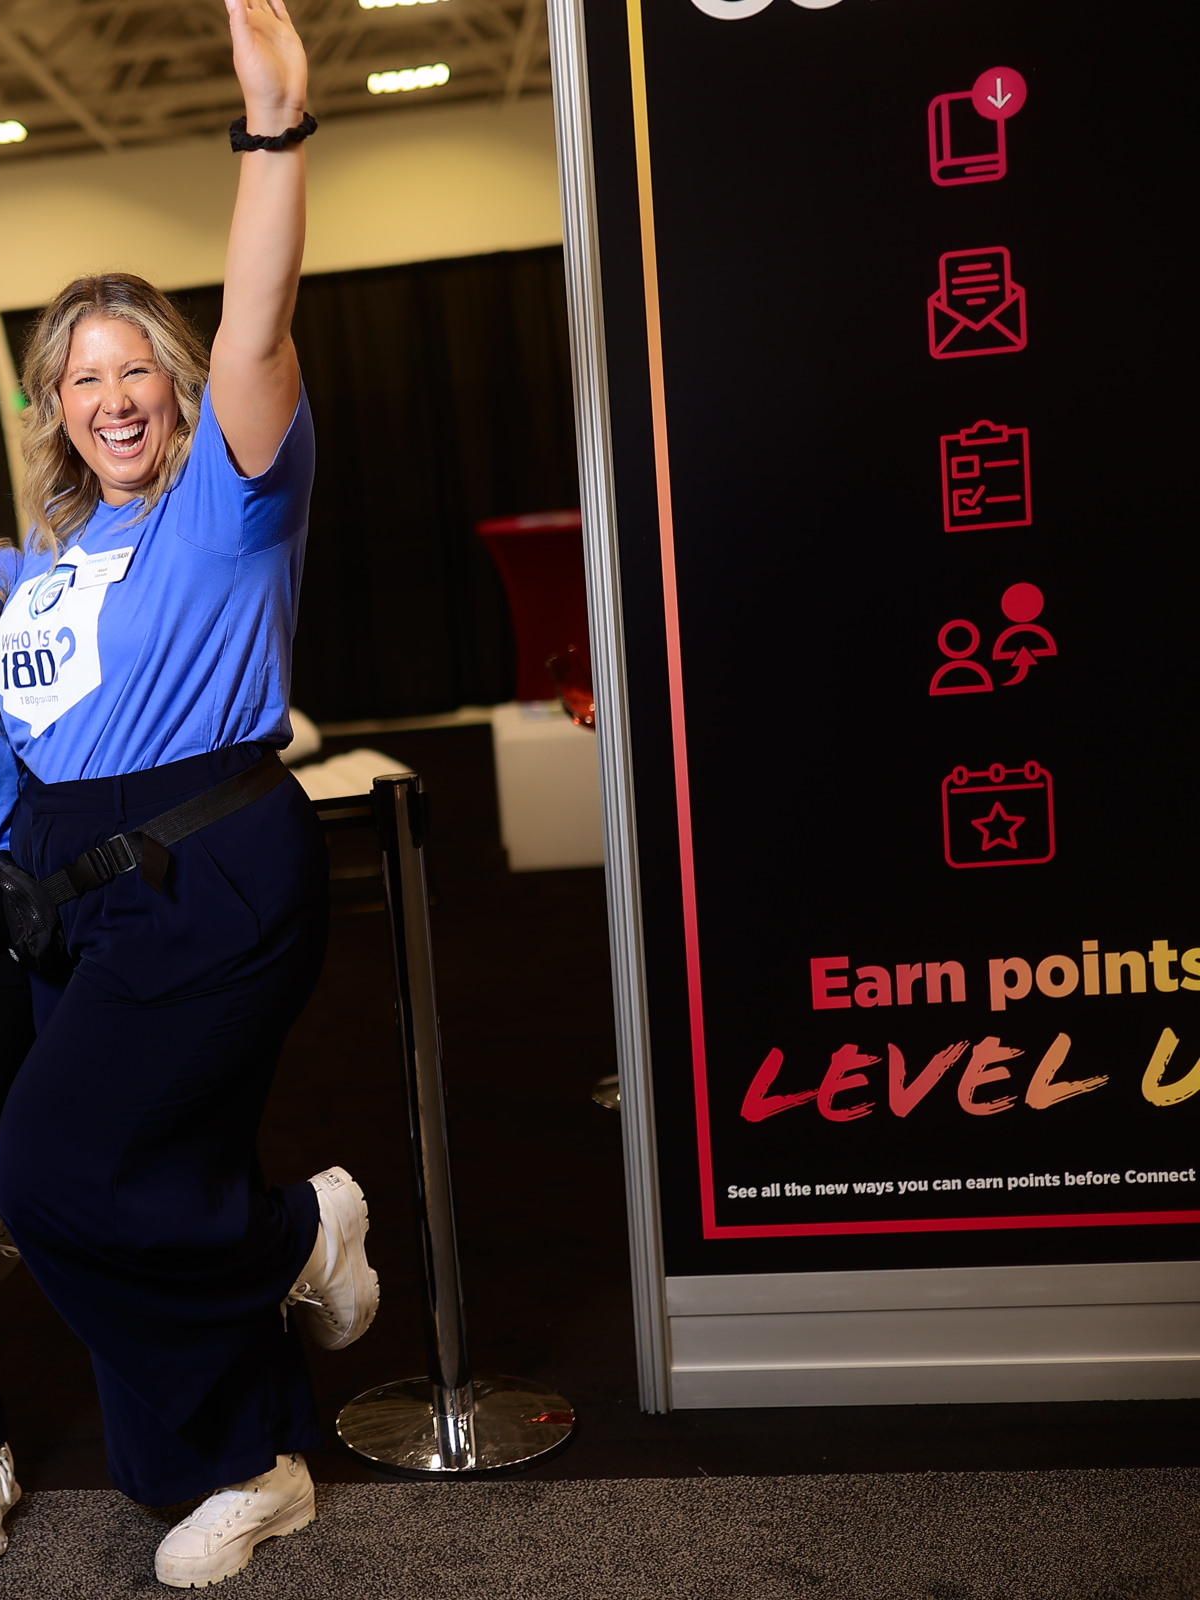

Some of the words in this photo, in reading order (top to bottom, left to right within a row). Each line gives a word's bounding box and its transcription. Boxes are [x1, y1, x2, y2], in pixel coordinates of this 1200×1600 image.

[1, 631, 31, 652] WHO
[37, 629, 51, 648] IS
[810, 955, 967, 1011] Earn
[740, 1031, 1110, 1123] LEVEL
[727, 1184, 758, 1199] See
[760, 1183, 781, 1198] all
[784, 1182, 811, 1197] the
[814, 1183, 849, 1196] new
[852, 1180, 894, 1195] ways
[898, 1180, 929, 1195] you
[932, 1178, 962, 1191] can
[965, 1176, 1004, 1190] earn
[1007, 1172, 1061, 1191] points
[1064, 1170, 1121, 1186] before
[1124, 1168, 1197, 1184] Connect
